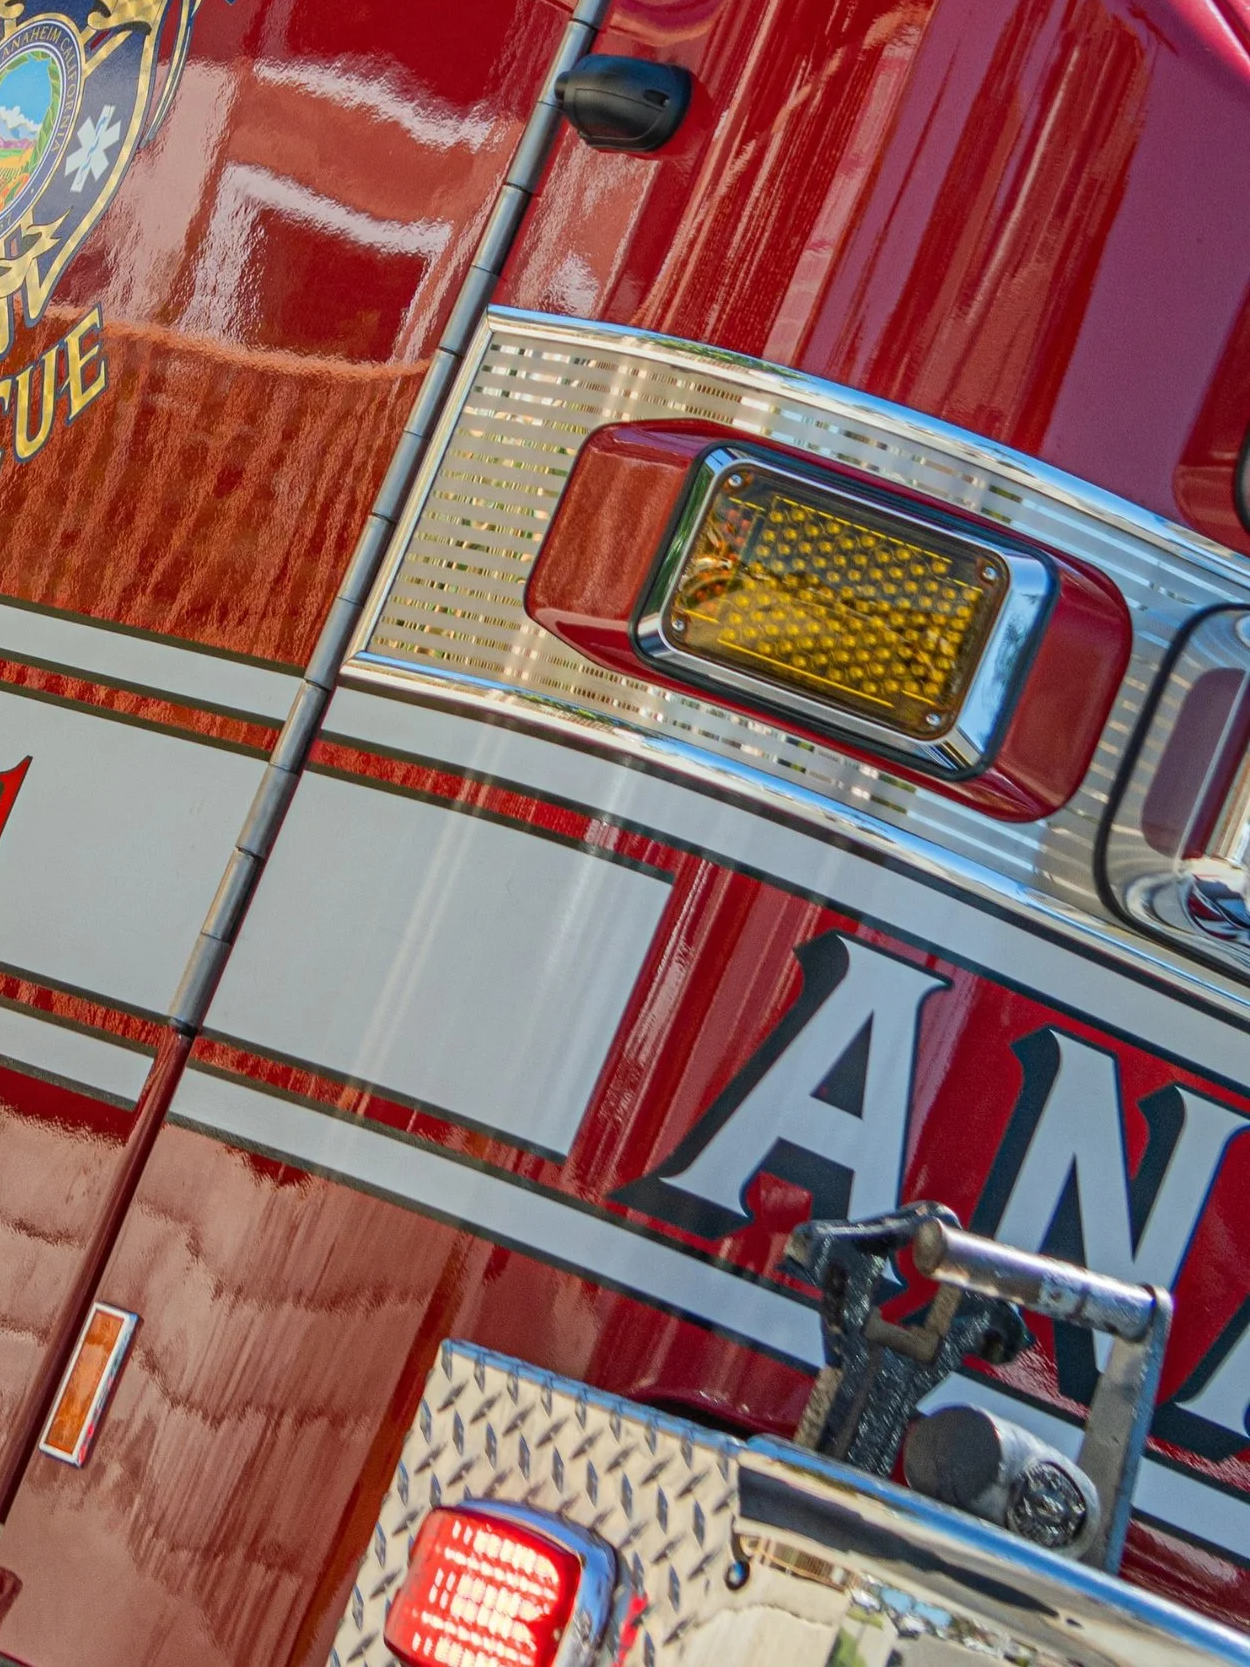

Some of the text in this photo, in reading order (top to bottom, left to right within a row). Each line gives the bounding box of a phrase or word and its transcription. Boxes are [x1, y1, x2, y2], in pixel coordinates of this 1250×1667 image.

[0, 24, 62, 61] ANAHEIM
[50, 36, 78, 153] CALIFORNIA
[610, 928, 1250, 1462] AN
